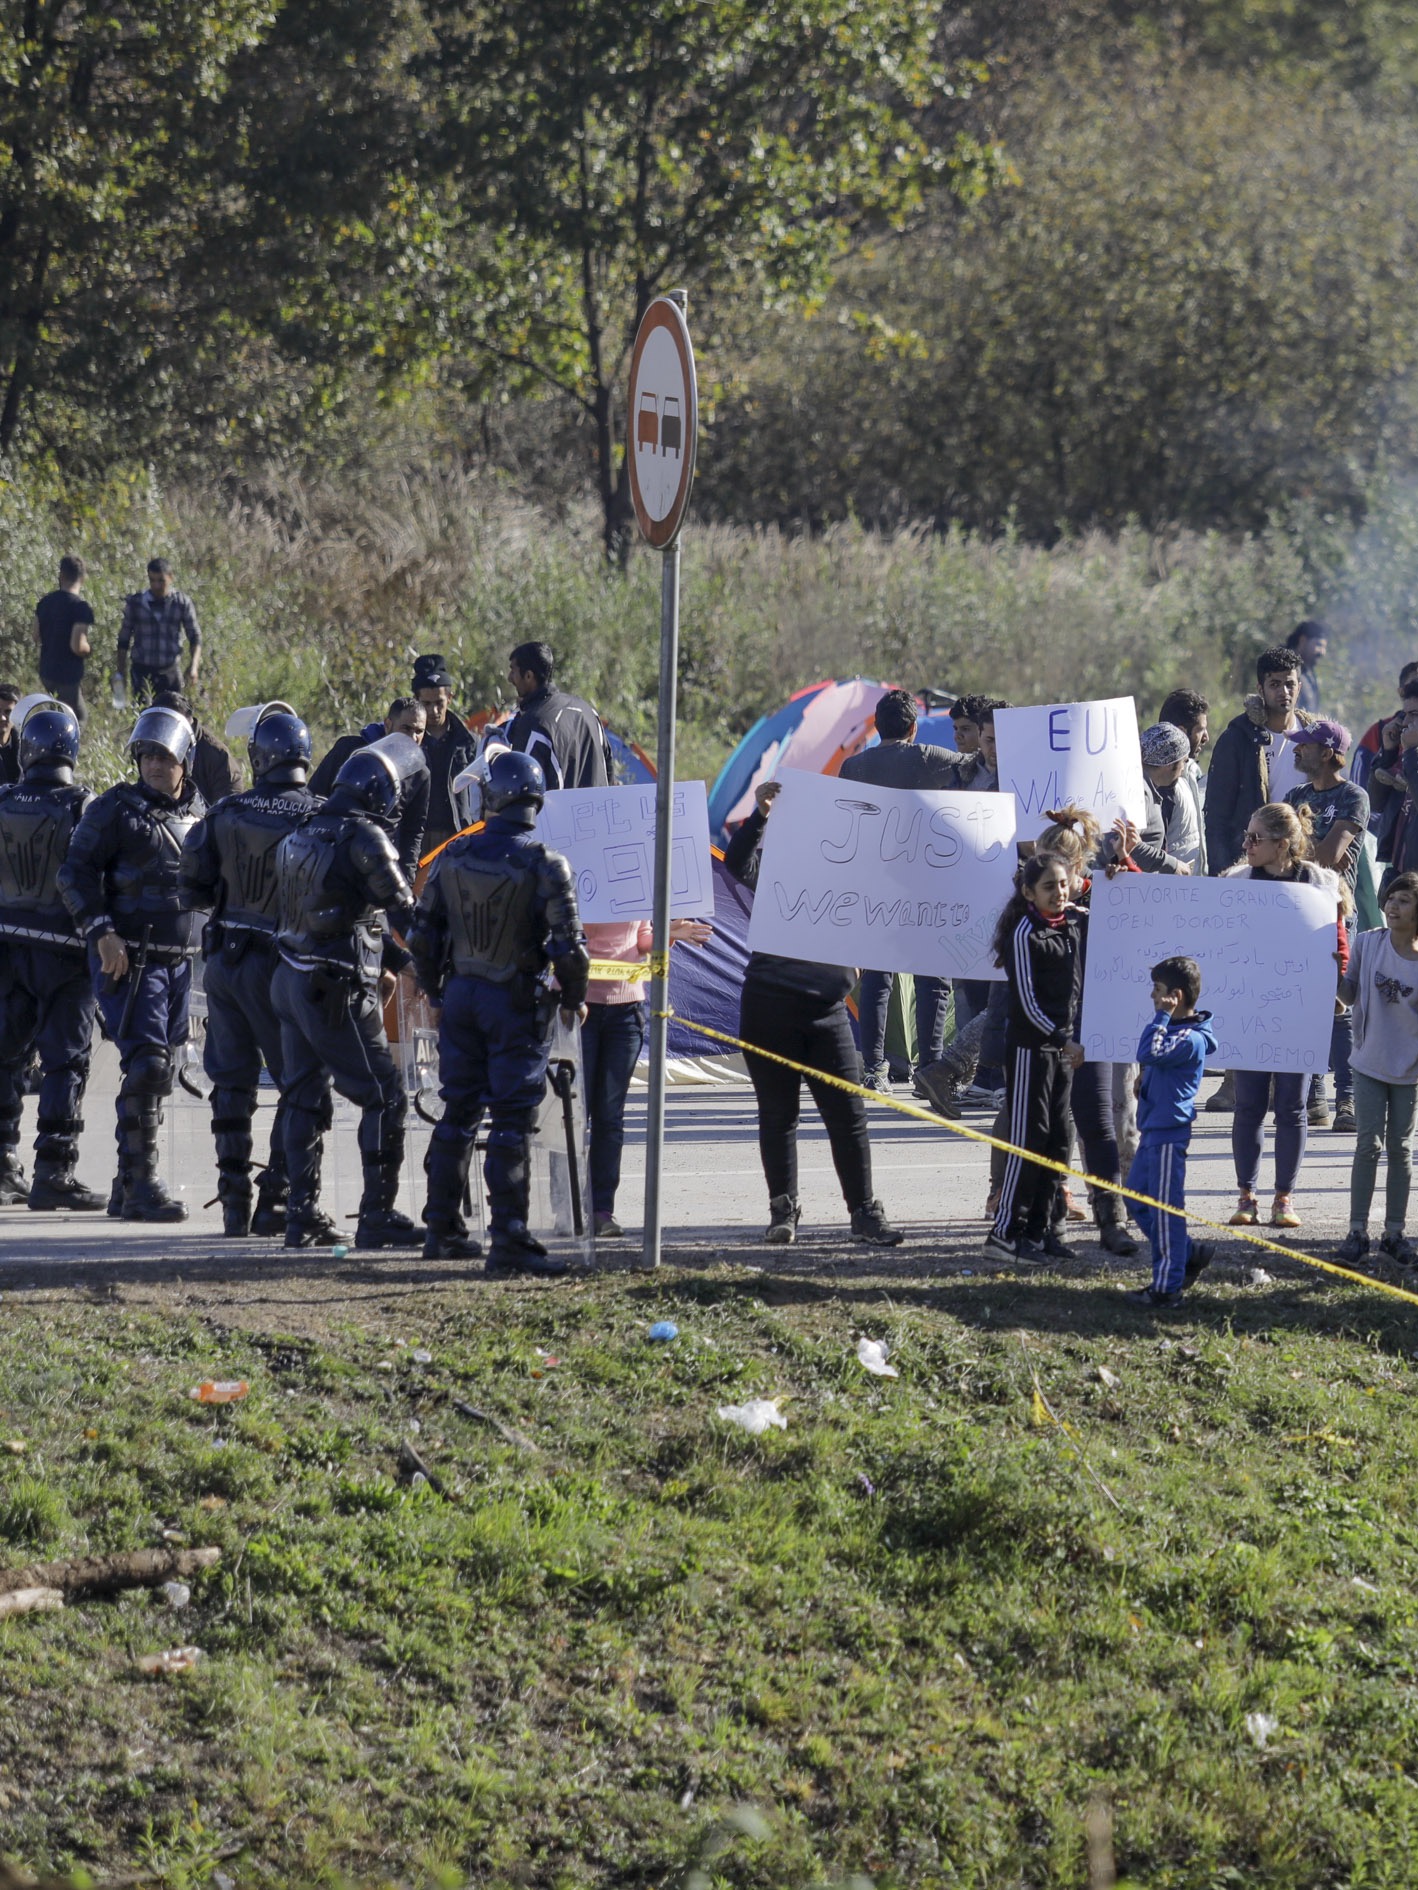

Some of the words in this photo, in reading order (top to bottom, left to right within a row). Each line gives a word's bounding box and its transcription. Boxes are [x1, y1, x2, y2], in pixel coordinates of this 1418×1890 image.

[1108, 886, 1199, 906] OTVORITE
[1219, 889, 1303, 911] GRANICE
[1107, 912, 1154, 931] OPEN
[1173, 913, 1250, 930] BORDER
[1241, 1016, 1283, 1034] VAS
[1221, 1041, 1243, 1060] DA
[1255, 1042, 1315, 1067] IDEMO
